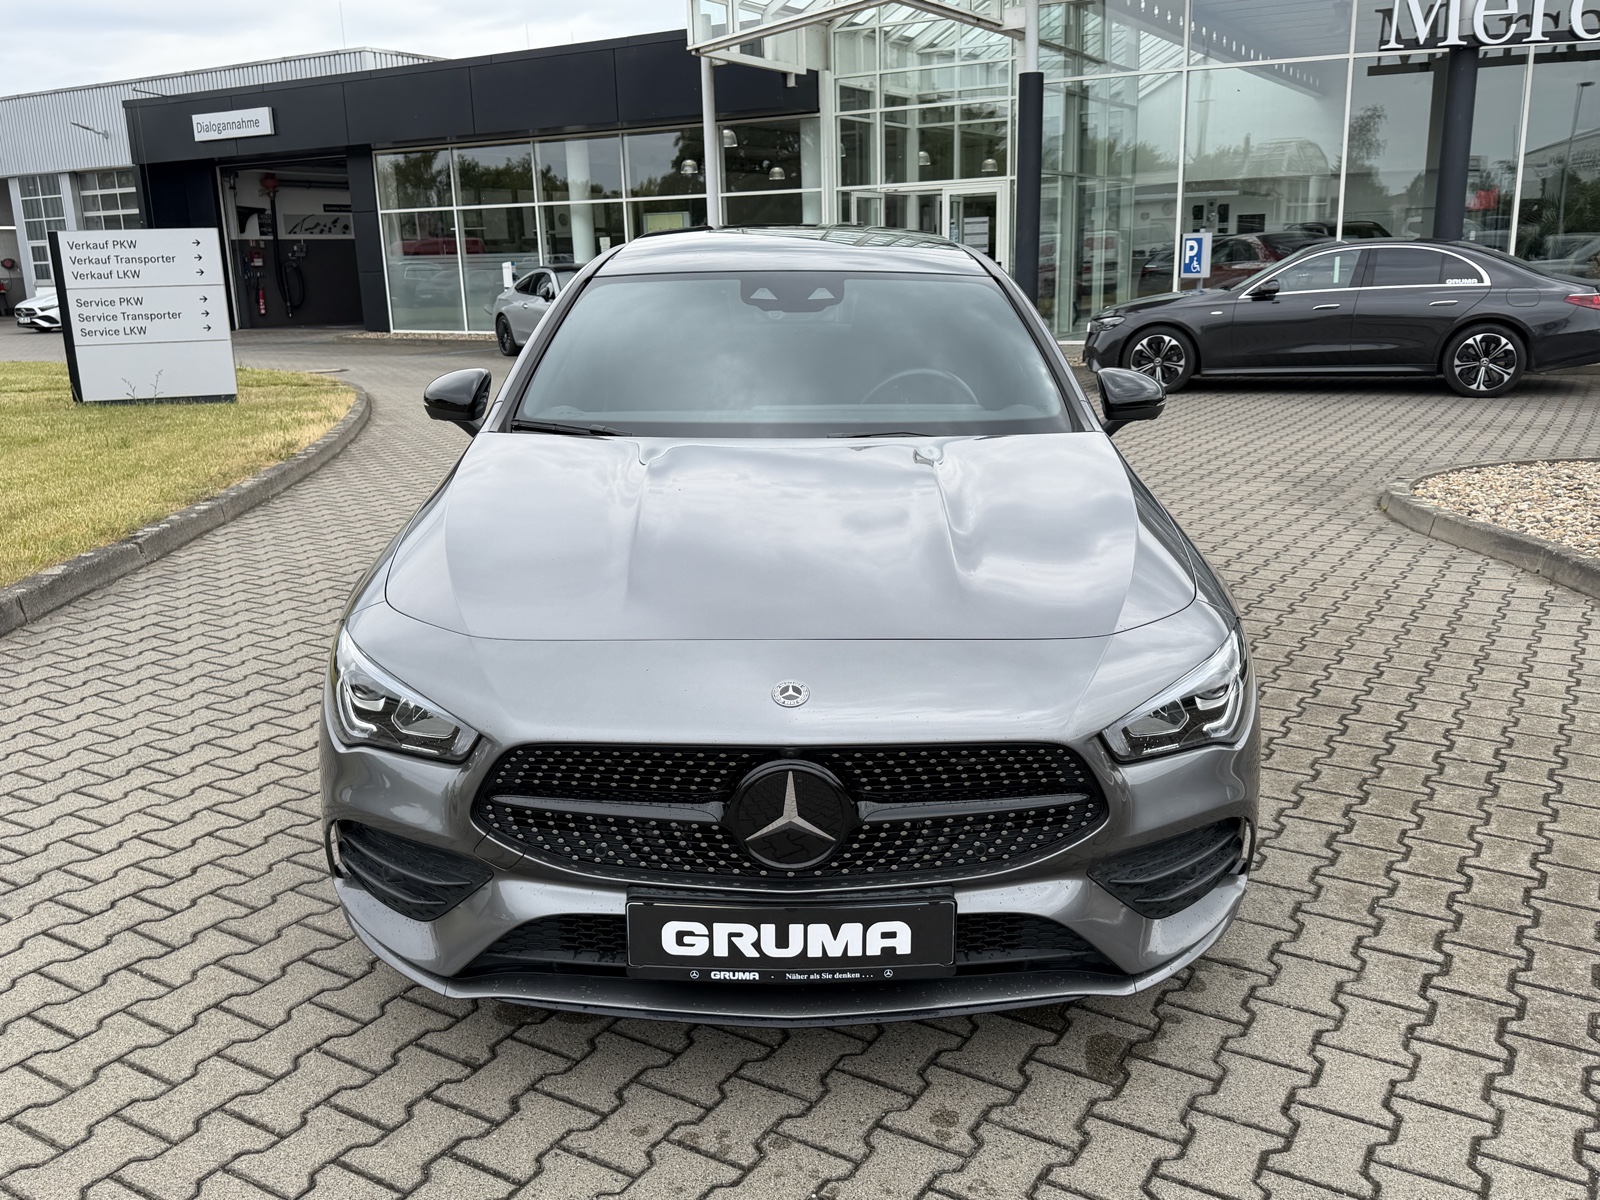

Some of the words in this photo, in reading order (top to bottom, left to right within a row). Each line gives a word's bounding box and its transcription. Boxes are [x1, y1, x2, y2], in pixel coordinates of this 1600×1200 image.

[196, 118, 260, 135] Dialogannahme
[67, 240, 109, 250] Verkauf
[112, 240, 137, 249] PKW
[1185, 240, 1198, 264] P
[70, 256, 111, 266] Verkauf
[114, 254, 176, 266] Transporter
[72, 270, 113, 280] Verkauf
[117, 270, 141, 279] LKW
[76, 298, 116, 308] Service
[119, 297, 144, 306] PKW
[78, 313, 118, 322] Service
[120, 311, 182, 322] Transporter
[80, 328, 120, 337] Service
[124, 326, 147, 336] LKW
[661, 920, 912, 958] GRUMA
[710, 971, 759, 980] GRUMA
